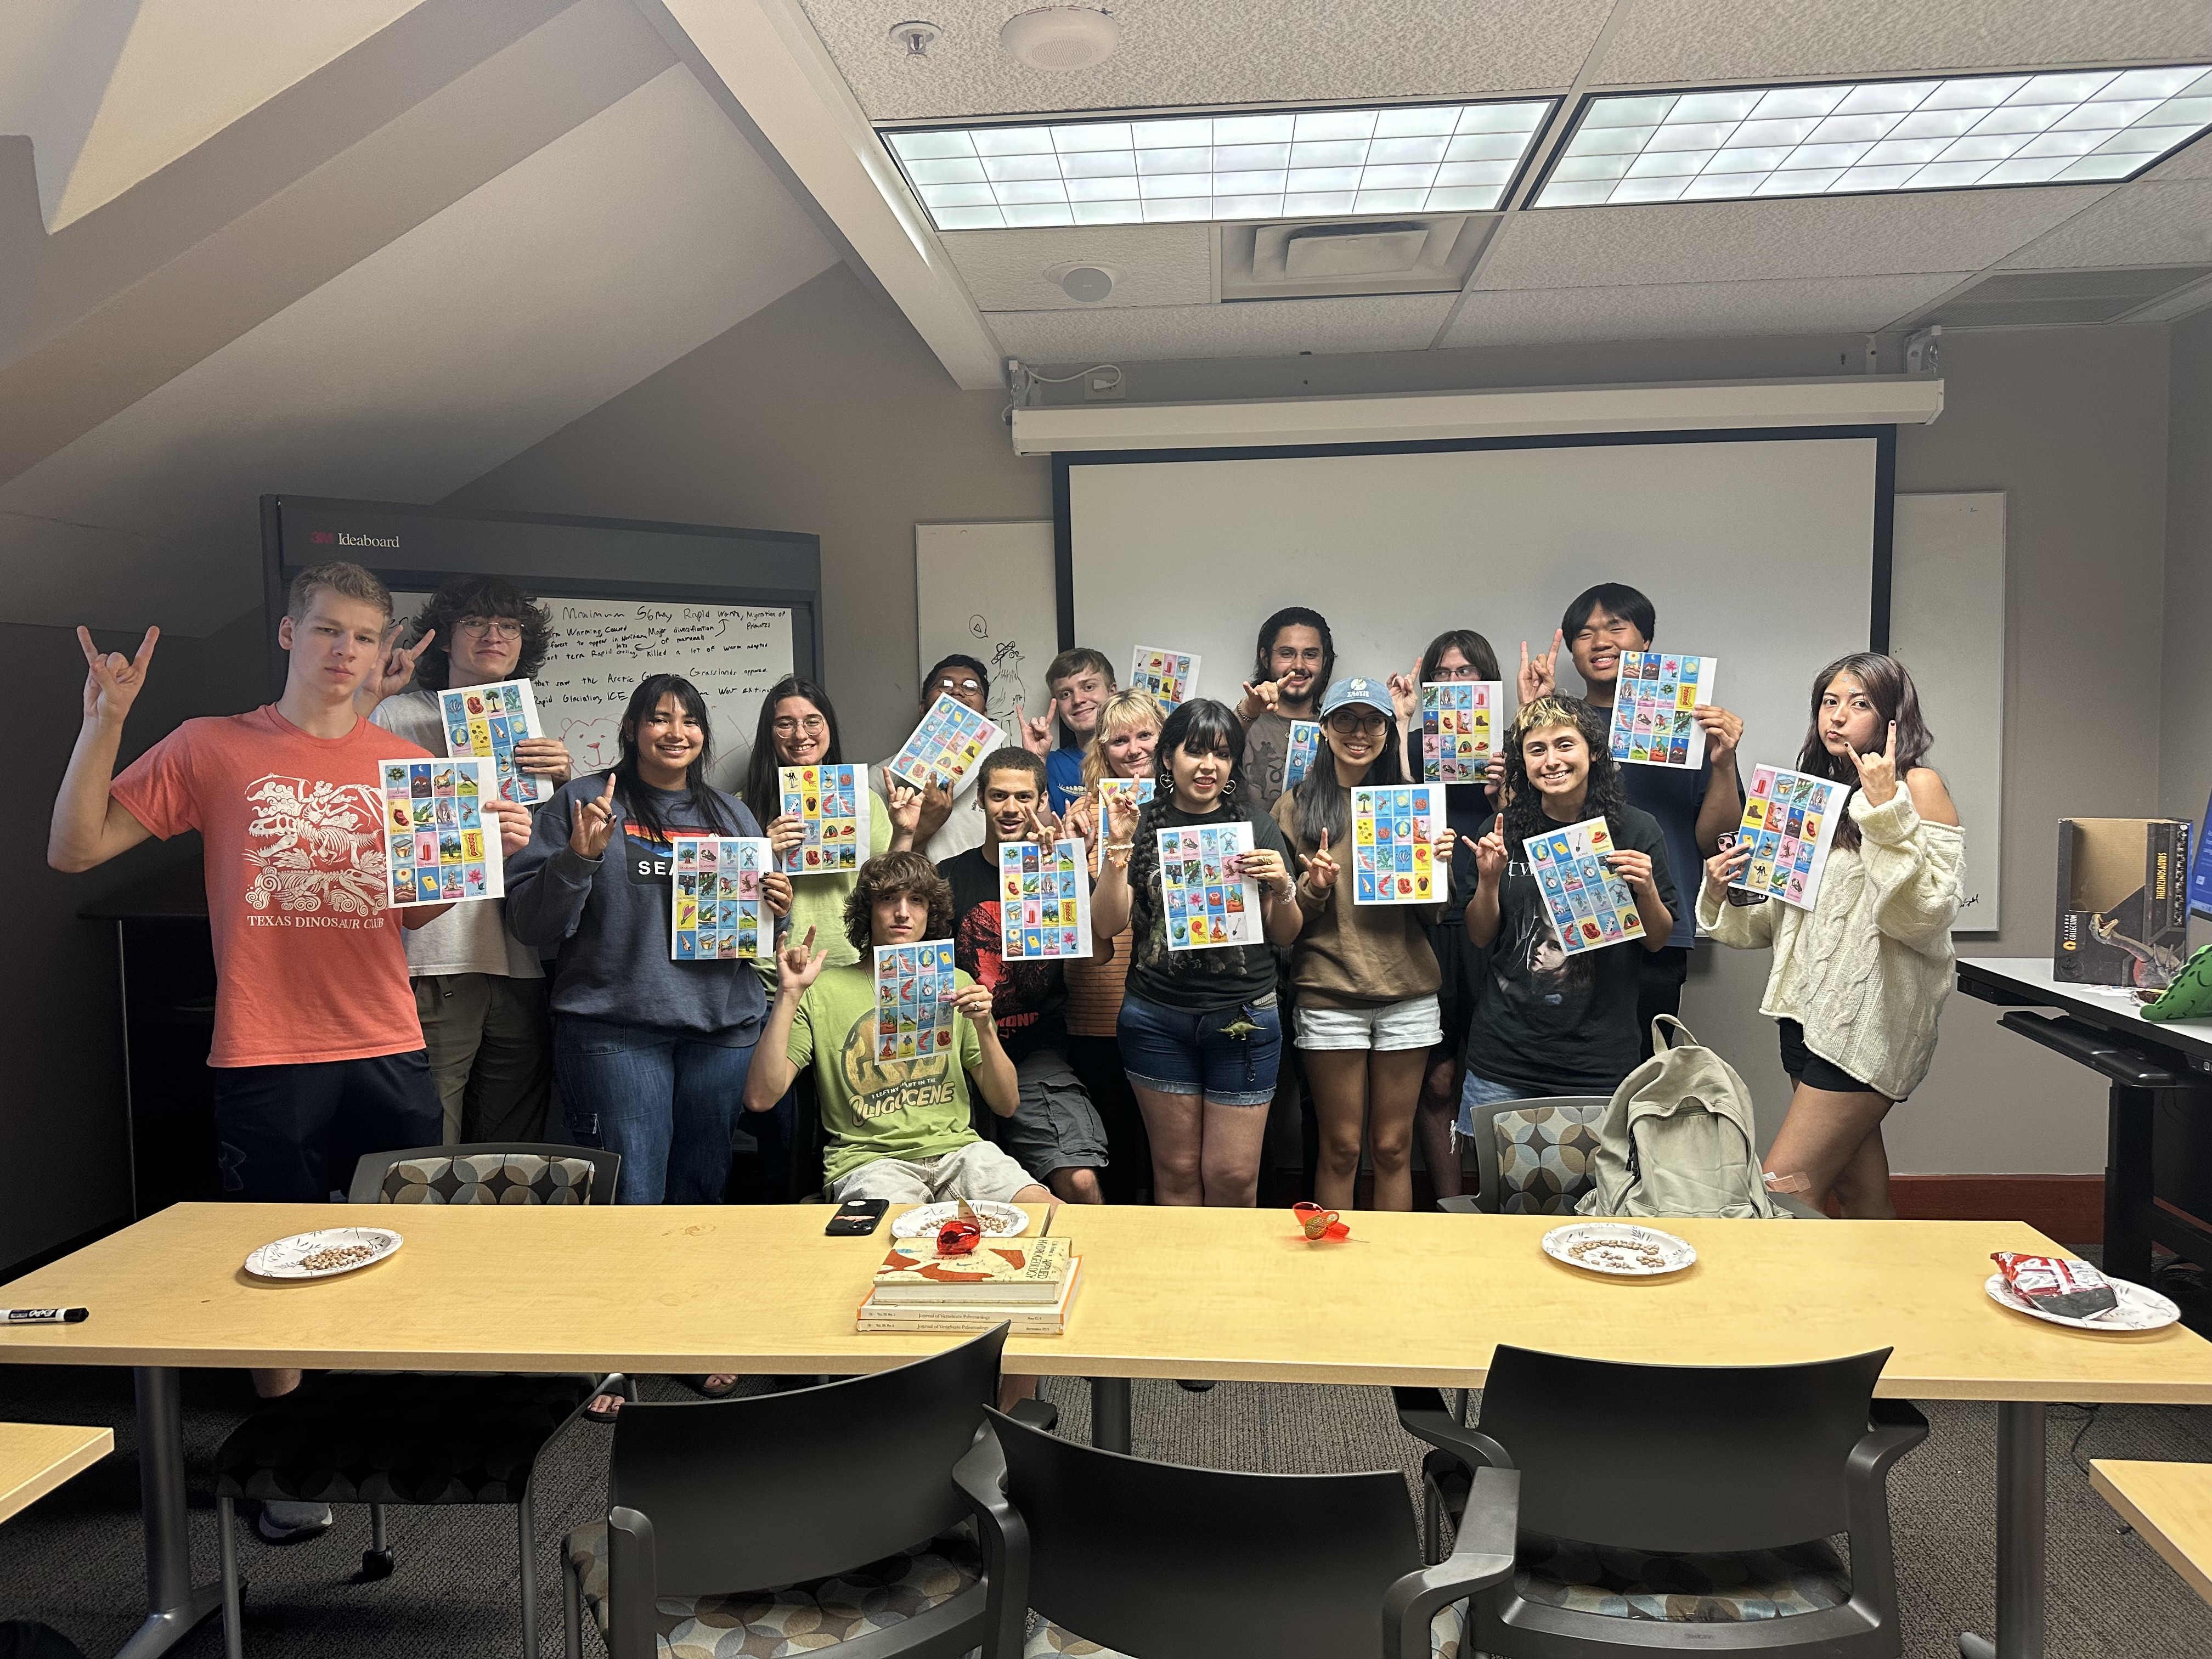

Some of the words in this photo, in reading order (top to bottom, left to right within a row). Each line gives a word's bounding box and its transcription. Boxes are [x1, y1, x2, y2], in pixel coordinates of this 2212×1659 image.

[338, 533, 399, 548] Ideaboard
[684, 608, 710, 622] Rapid
[648, 627, 666, 637] Major
[591, 648, 612, 658] Rapid
[607, 673, 634, 683] Arctic
[534, 695, 552, 707] Rapid
[607, 691, 628, 701] ICE
[2156, 852, 2167, 899] THERIZINOSAURUS
[247, 916, 291, 926] TEXAS
[295, 917, 359, 929] DINOSAUR
[363, 918, 384, 929] CLUB
[2069, 915, 2077, 940] COLLECTION
[876, 1089, 890, 1098] LEFT
[849, 1081, 956, 1128] OLIGOCENE
[1025, 1239, 1048, 1279] HYDROGEOLOGY
[1037, 1259, 1053, 1279] APPLIED
